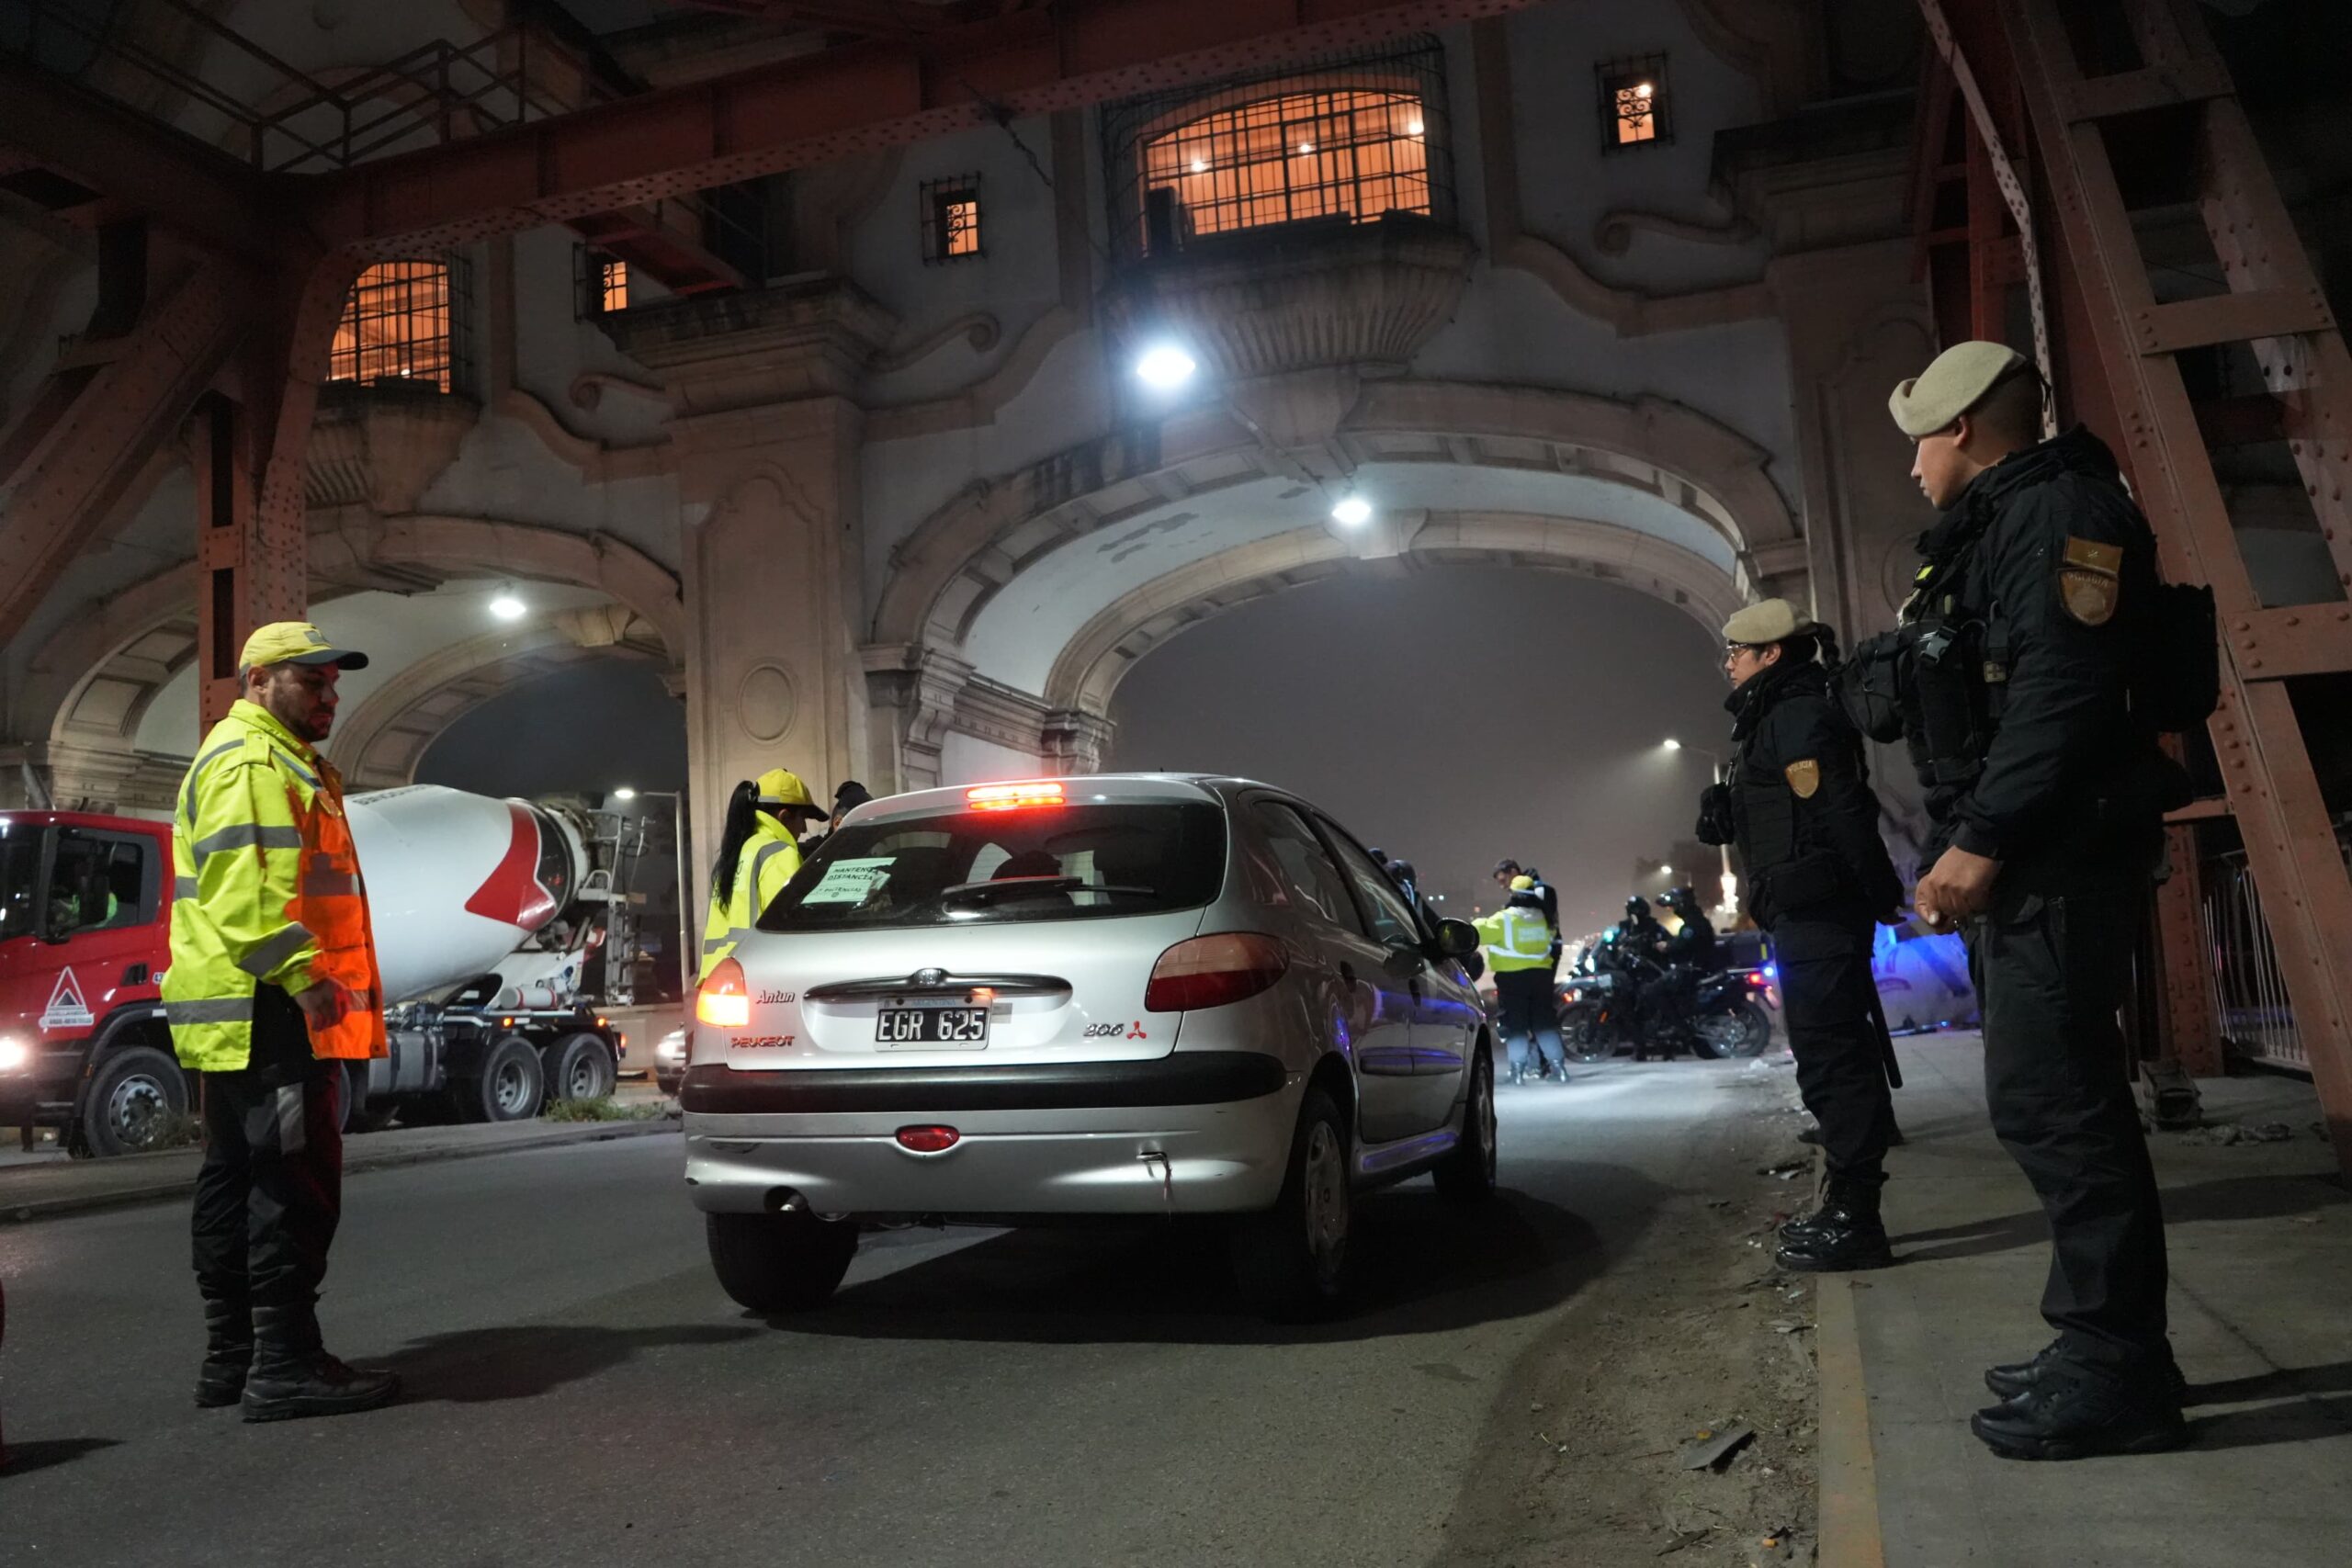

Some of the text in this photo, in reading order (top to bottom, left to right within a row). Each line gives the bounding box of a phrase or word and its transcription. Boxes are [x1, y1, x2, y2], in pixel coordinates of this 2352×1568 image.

[877, 1010, 985, 1041] EGR 625
[1083, 1023, 1125, 1037] 206
[731, 1035, 796, 1049] PEUGEOT
